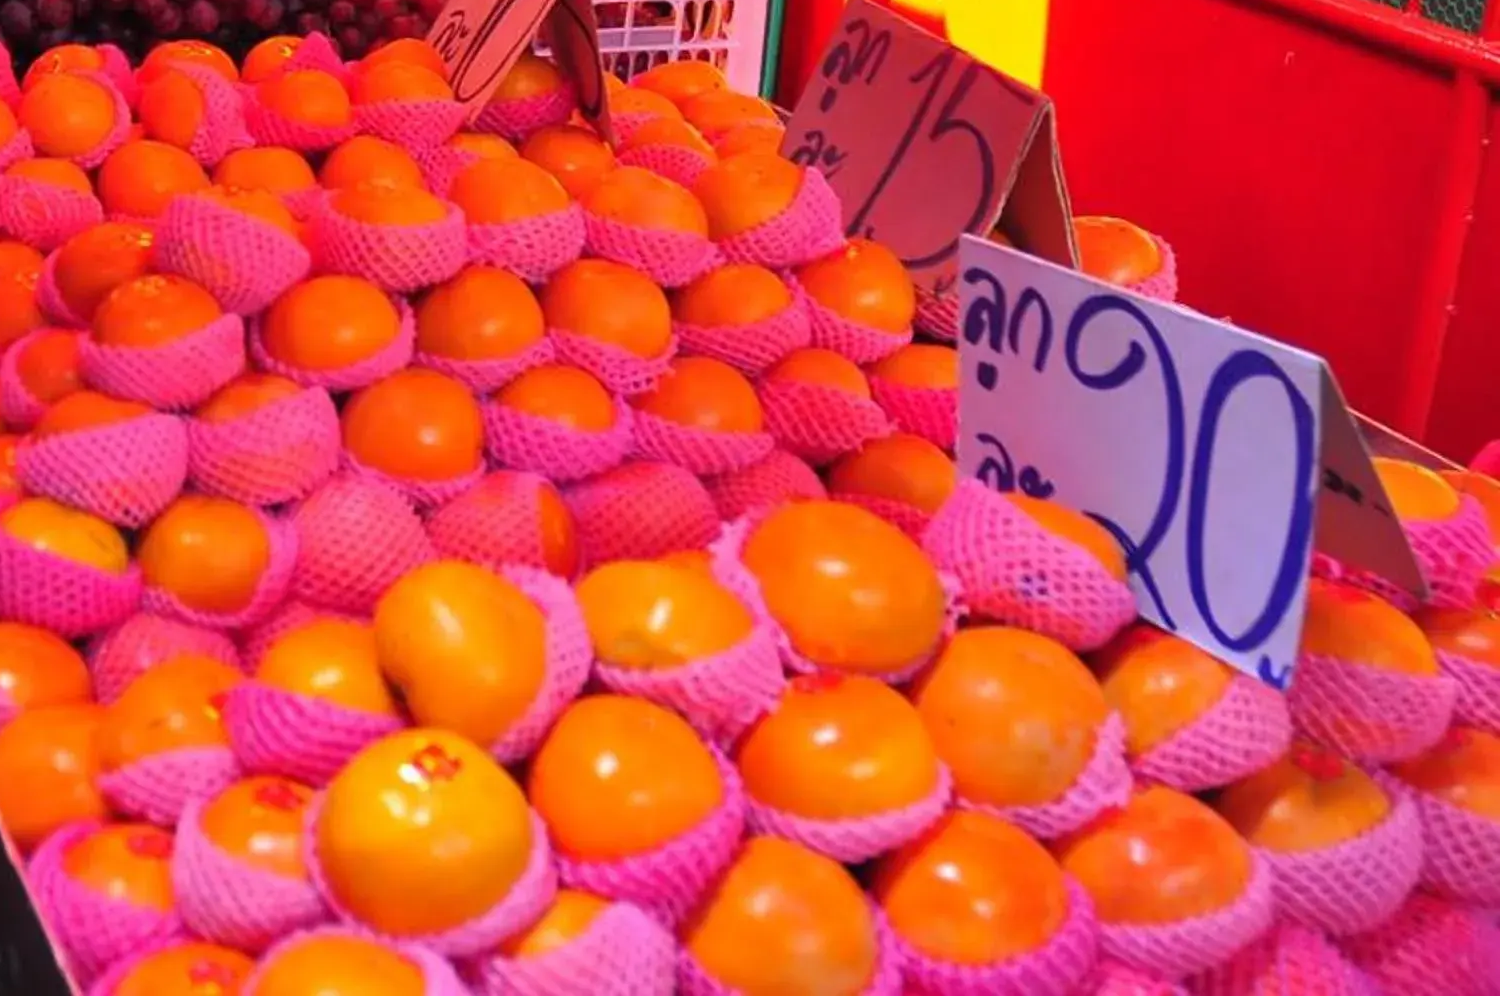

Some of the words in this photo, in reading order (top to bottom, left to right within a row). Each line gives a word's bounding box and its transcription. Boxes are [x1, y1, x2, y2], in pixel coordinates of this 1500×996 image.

[845, 42, 1037, 269] 15
[963, 266, 1054, 392] ลูก
[1065, 294, 1316, 652] 20
